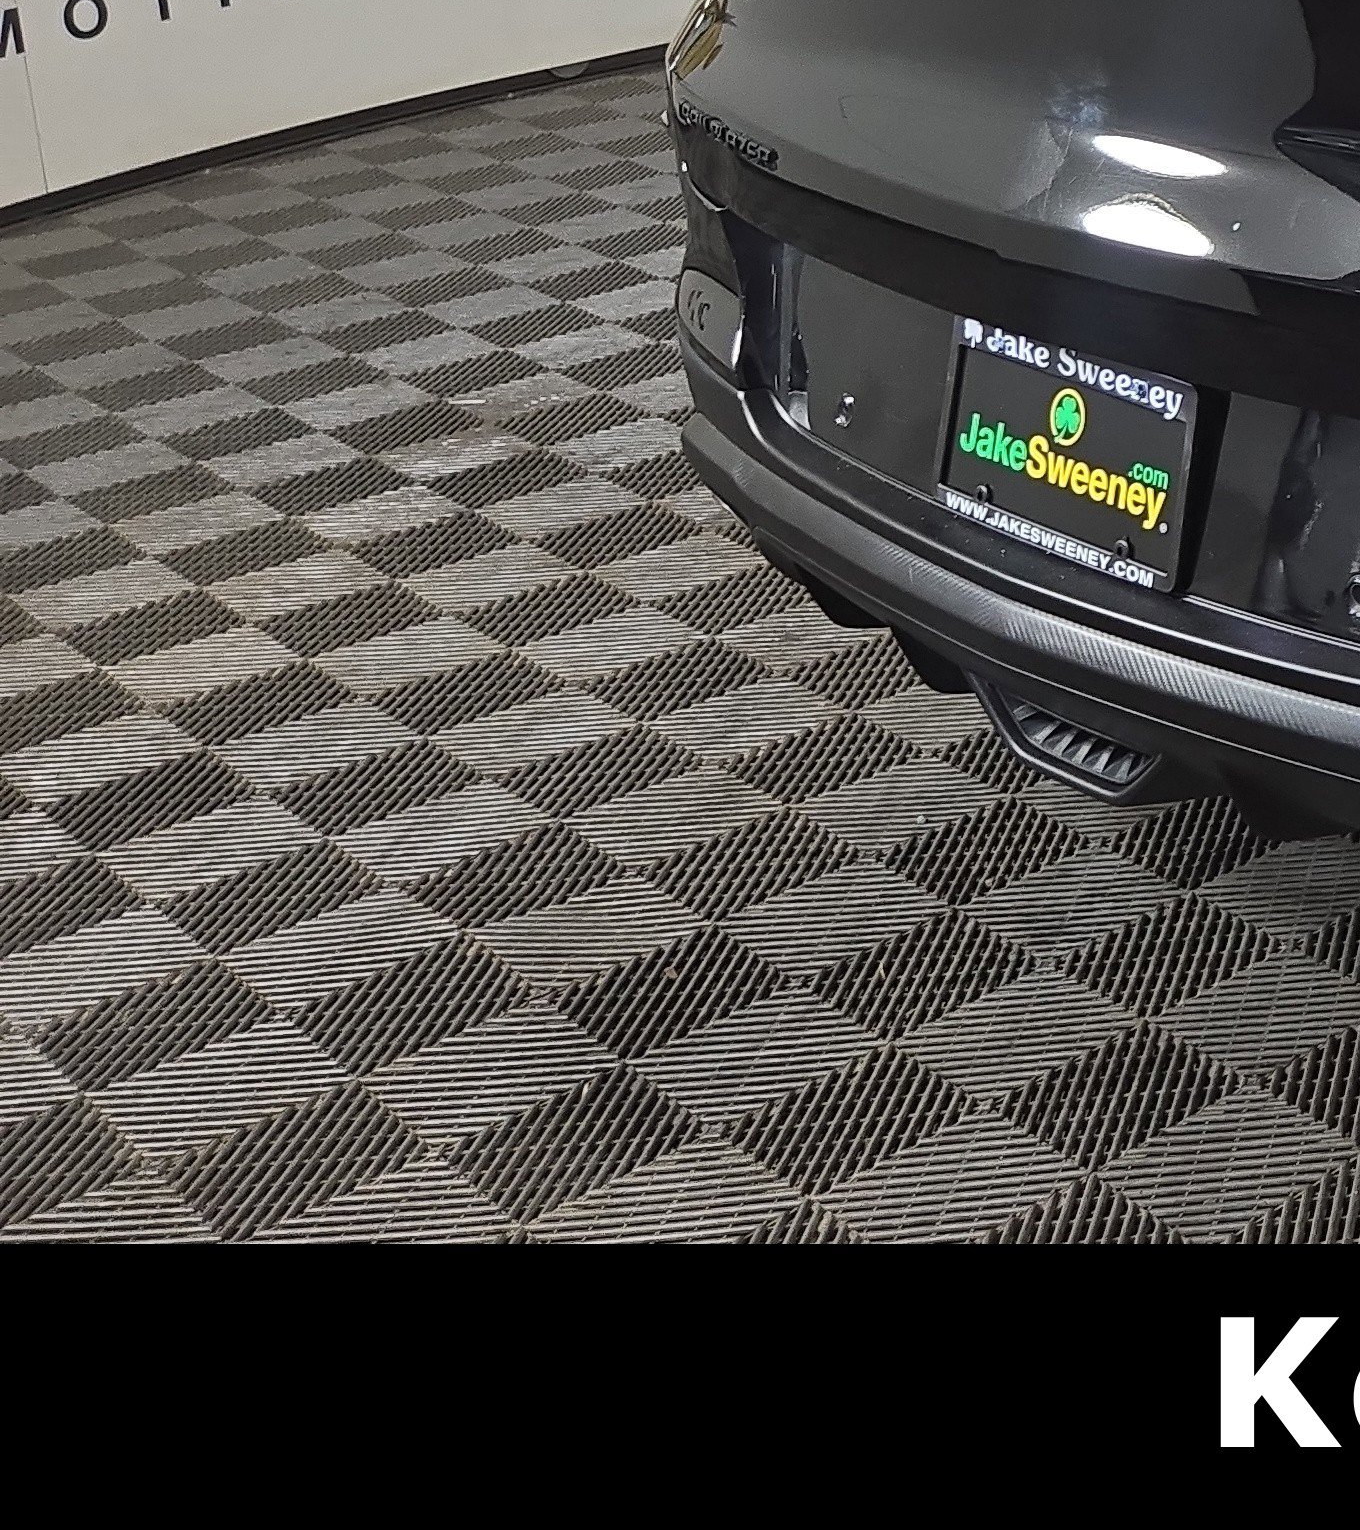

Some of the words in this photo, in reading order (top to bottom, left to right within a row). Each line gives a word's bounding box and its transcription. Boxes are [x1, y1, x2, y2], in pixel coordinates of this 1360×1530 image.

[986, 328, 1050, 369] Jake
[1057, 347, 1183, 419] Sweeney
[1128, 461, 1169, 490] .com
[946, 490, 1155, 589] WWW.JAKESWEENEY.COM
